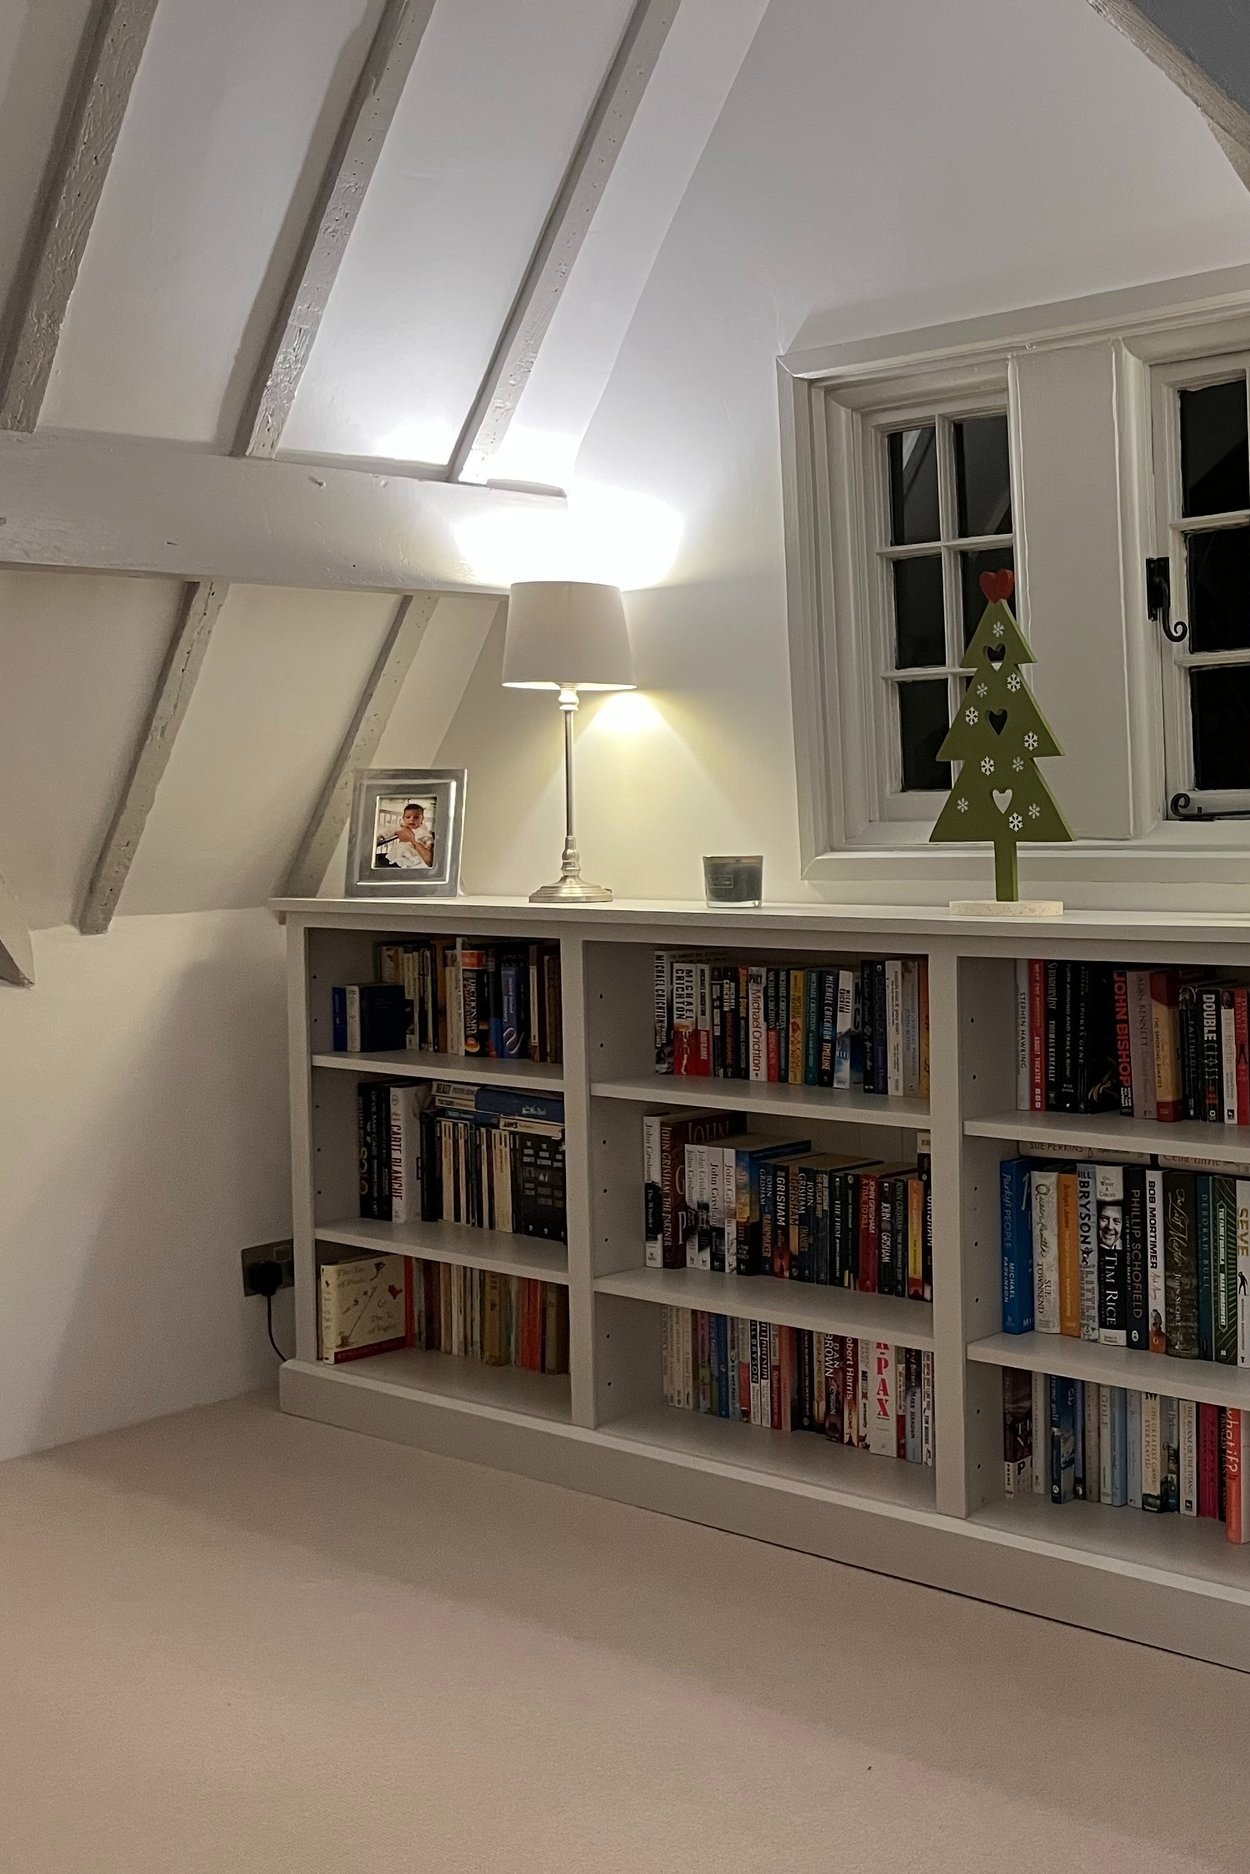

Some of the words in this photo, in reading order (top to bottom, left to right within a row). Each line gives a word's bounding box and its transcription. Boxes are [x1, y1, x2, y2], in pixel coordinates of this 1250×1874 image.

[655, 954, 666, 987] MICHAEL
[809, 972, 817, 998] MICHAEL
[823, 975, 833, 1005] MICHAEL
[1137, 977, 1146, 1003] ALAN
[655, 988, 666, 1024] CRICHTON
[675, 969, 685, 1020] CRICHTON
[685, 969, 694, 1020] MICHAEL
[752, 988, 763, 1029] Michael
[1114, 972, 1126, 1020] JOHN
[809, 998, 817, 1031] CRICHTON
[823, 1006, 833, 1040] CRICHTON
[1138, 1004, 1148, 1046] BENNETT
[752, 1029, 763, 1072] Crichton
[822, 1042, 832, 1071] TIMELINE
[1116, 1023, 1131, 1086] BISHOP
[391, 1124, 402, 1154] CARTE
[661, 1126, 672, 1151] JOHN
[391, 1158, 402, 1201] BLANCHE
[661, 1152, 672, 1194] GRISHAM
[1147, 1181, 1156, 1204] BOB
[662, 1197, 672, 1212] THE
[777, 1176, 786, 1226] GRISHAM
[798, 1173, 806, 1215] GRISHAM
[881, 1202, 891, 1221] JOHN
[1079, 1180, 1092, 1245] BRYSON
[1130, 1189, 1141, 1238] PHILLIP
[663, 1212, 673, 1247] PARTNER
[1149, 1207, 1158, 1269] MORTIMER
[1201, 1193, 1209, 1251] DEBORAH
[1237, 1207, 1249, 1257] SEVE
[881, 1232, 891, 1263] GRISHAM
[1036, 1261, 1045, 1314] TOWNSEND
[1044, 1278, 1052, 1297] SUE
[1105, 1251, 1118, 1287] TIM
[1131, 1242, 1143, 1318] SCHOFIELD
[1174, 1272, 1182, 1295] JOHN
[1085, 1270, 1096, 1322] LITTLE
[1105, 1290, 1118, 1327] RICE
[1174, 1297, 1182, 1327] SUCHET
[825, 1334, 833, 1377] BROWN
[1173, 1343, 1192, 1402] DANCER
[846, 1367, 854, 1400] Harris
